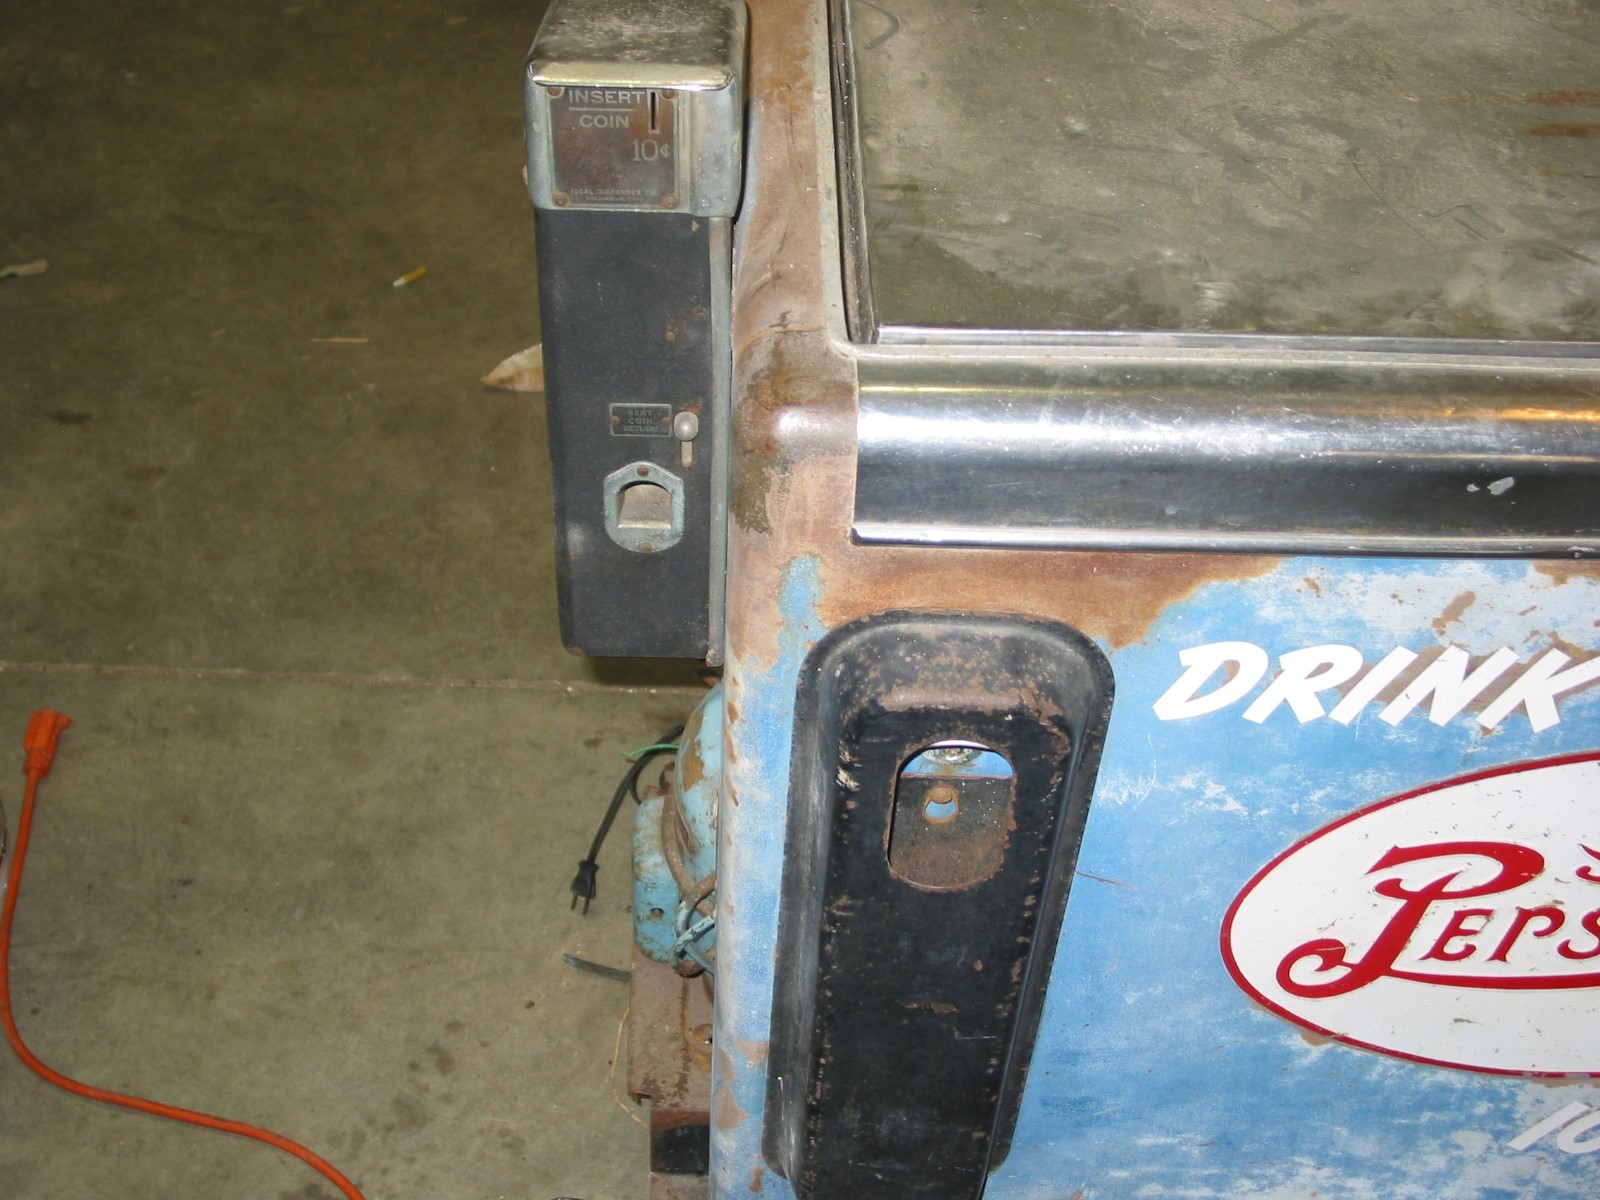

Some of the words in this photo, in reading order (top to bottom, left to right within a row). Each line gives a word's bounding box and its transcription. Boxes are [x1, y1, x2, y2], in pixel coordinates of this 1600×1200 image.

[568, 90, 646, 104] INSERT
[579, 115, 630, 129] COIN
[627, 417, 654, 425] COIN
[1152, 641, 1600, 733] DRINK
